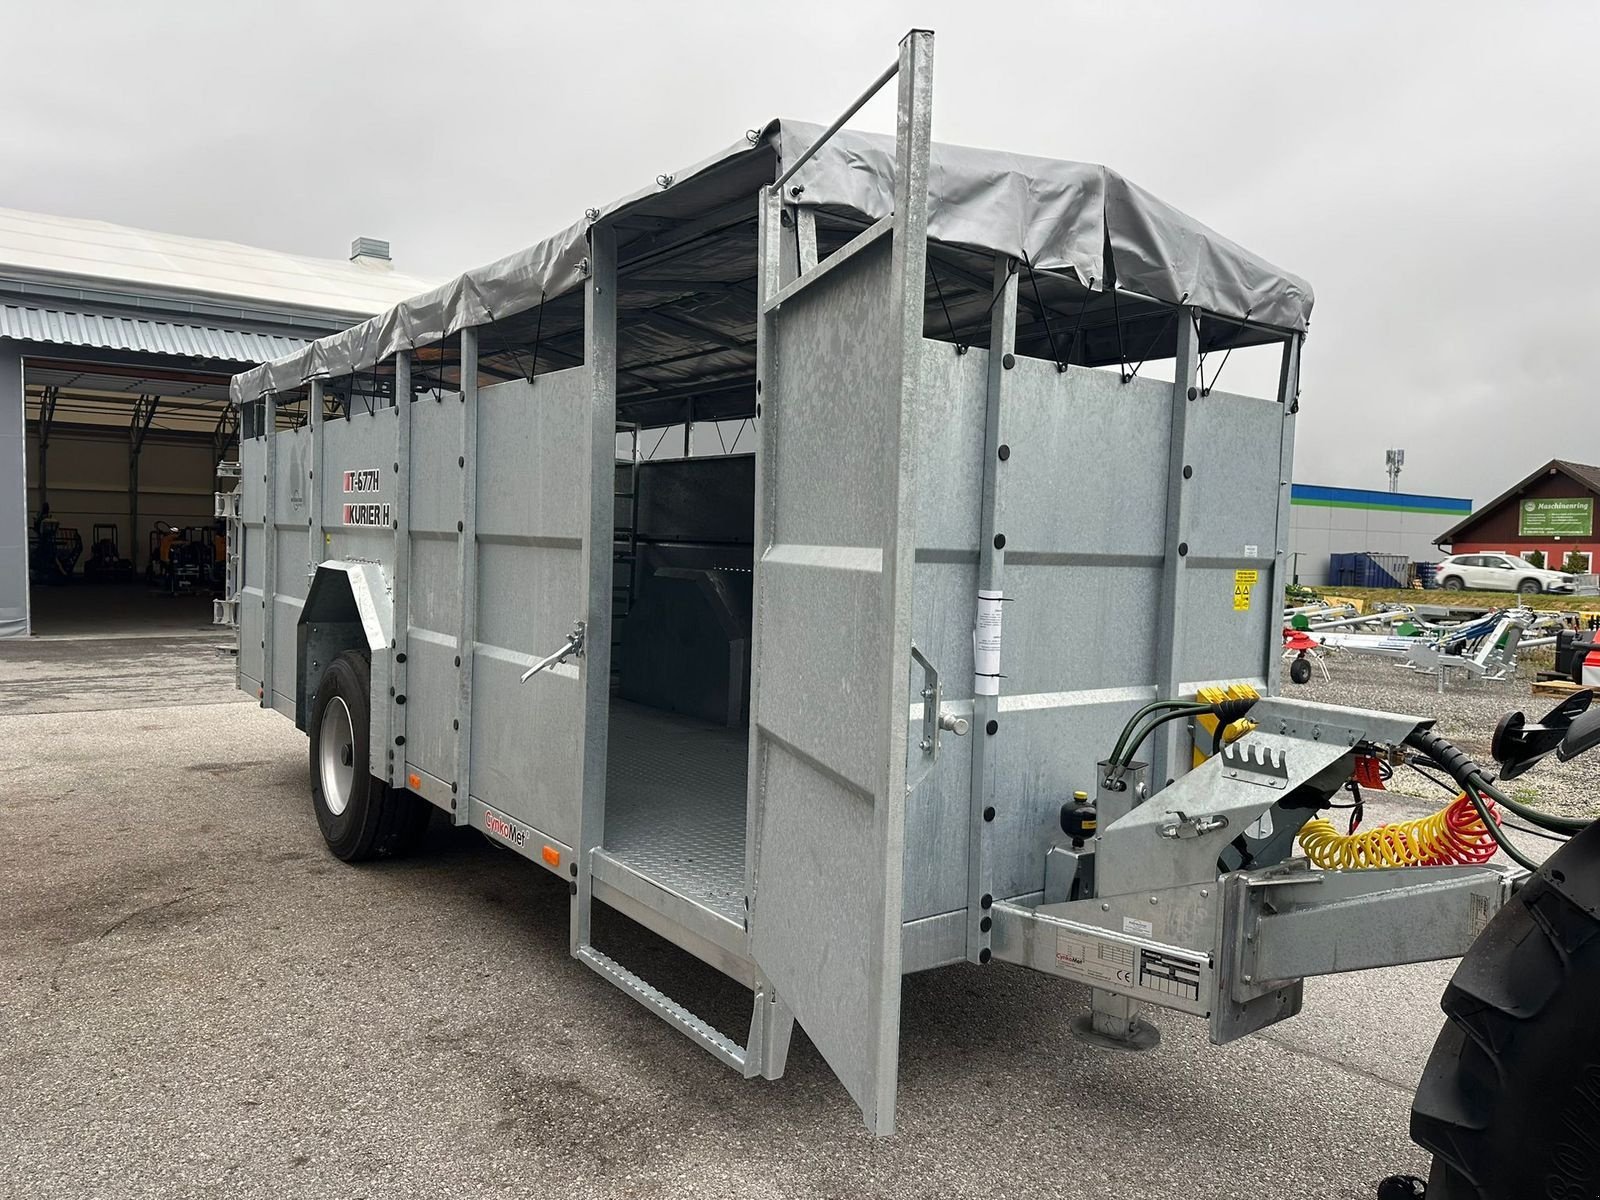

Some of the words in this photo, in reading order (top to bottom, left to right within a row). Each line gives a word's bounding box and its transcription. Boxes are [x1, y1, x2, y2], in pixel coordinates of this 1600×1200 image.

[349, 469, 379, 492] T-677H
[349, 504, 381, 525] KURIER
[382, 504, 390, 526] H
[1538, 502, 1589, 511] Maschinenring
